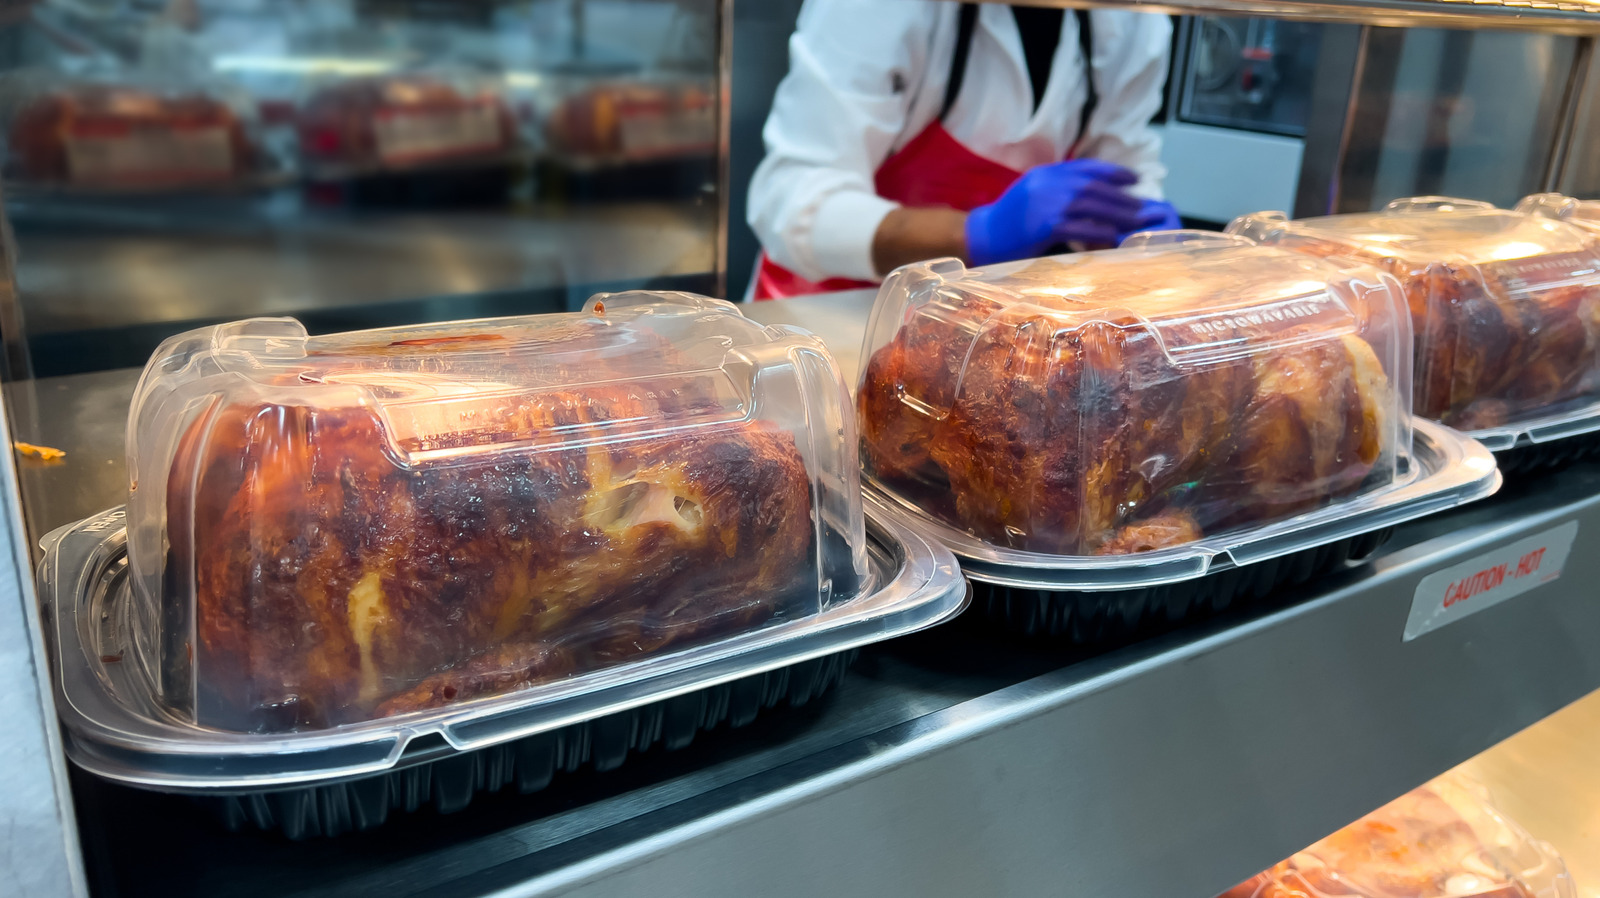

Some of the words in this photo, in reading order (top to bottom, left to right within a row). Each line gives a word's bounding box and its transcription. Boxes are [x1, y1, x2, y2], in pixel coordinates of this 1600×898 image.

[1188, 303, 1321, 334] MICROWAVABLE
[1443, 563, 1508, 608] CAUTION
[1514, 547, 1547, 579] HOT
